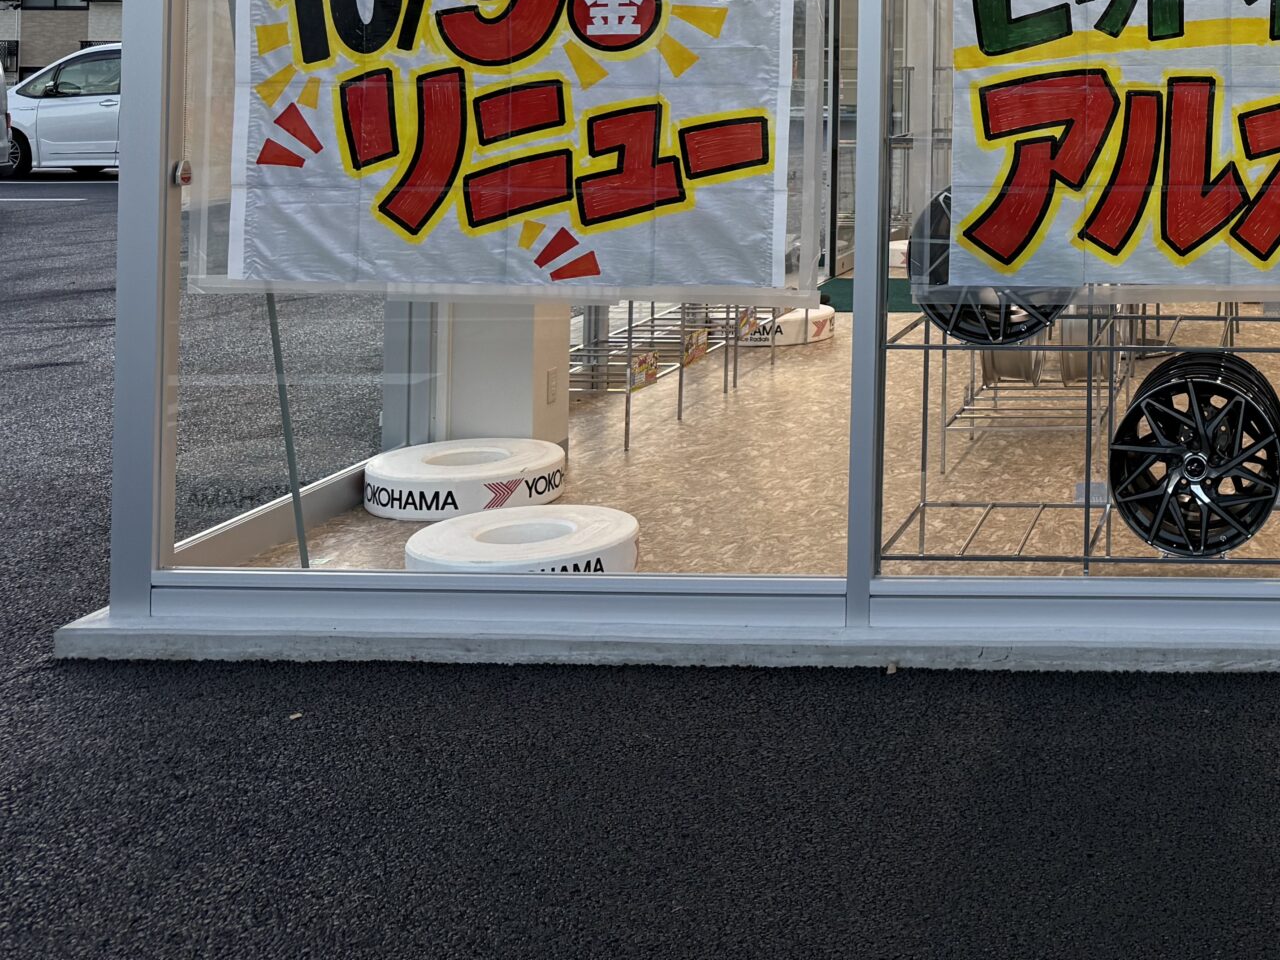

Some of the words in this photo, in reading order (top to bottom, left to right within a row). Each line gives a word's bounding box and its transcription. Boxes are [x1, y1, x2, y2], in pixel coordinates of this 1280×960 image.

[339, 67, 770, 236] リニュー
[365, 482, 459, 511] OKOHAMA
